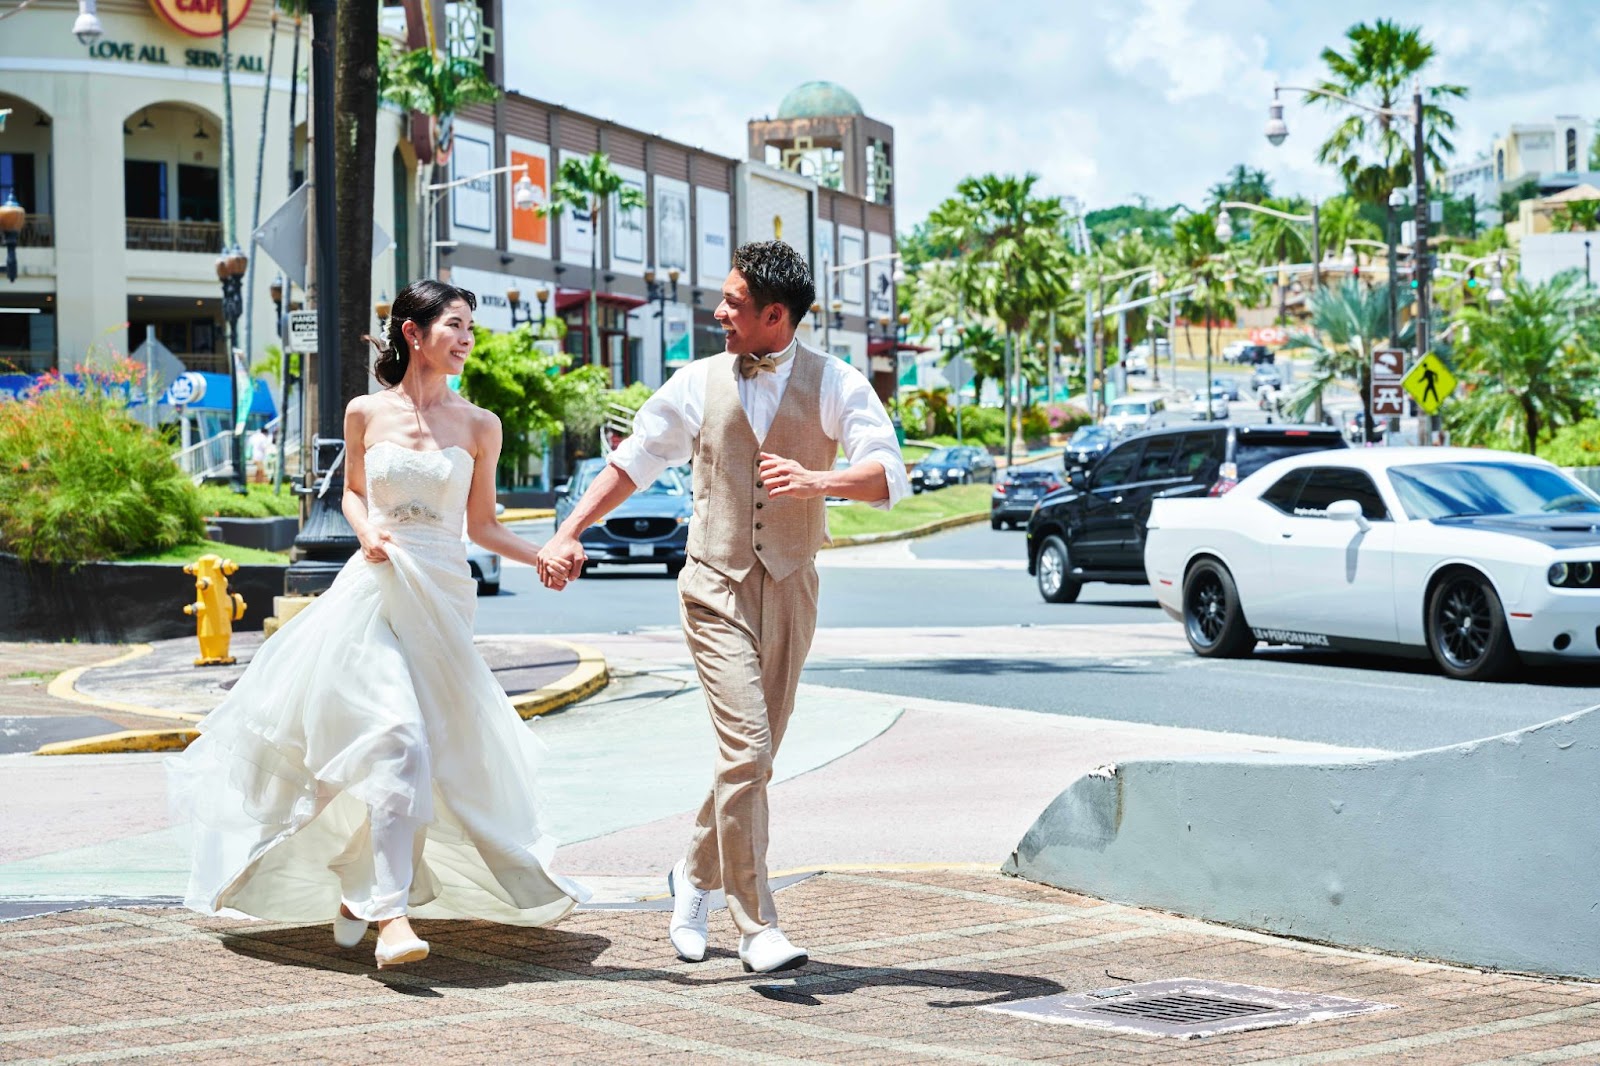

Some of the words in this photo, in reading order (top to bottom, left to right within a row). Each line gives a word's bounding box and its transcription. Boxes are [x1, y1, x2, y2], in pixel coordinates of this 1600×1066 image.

[89, 41, 135, 60] LOVE
[138, 44, 169, 64] ALL
[237, 54, 264, 72] ALL
